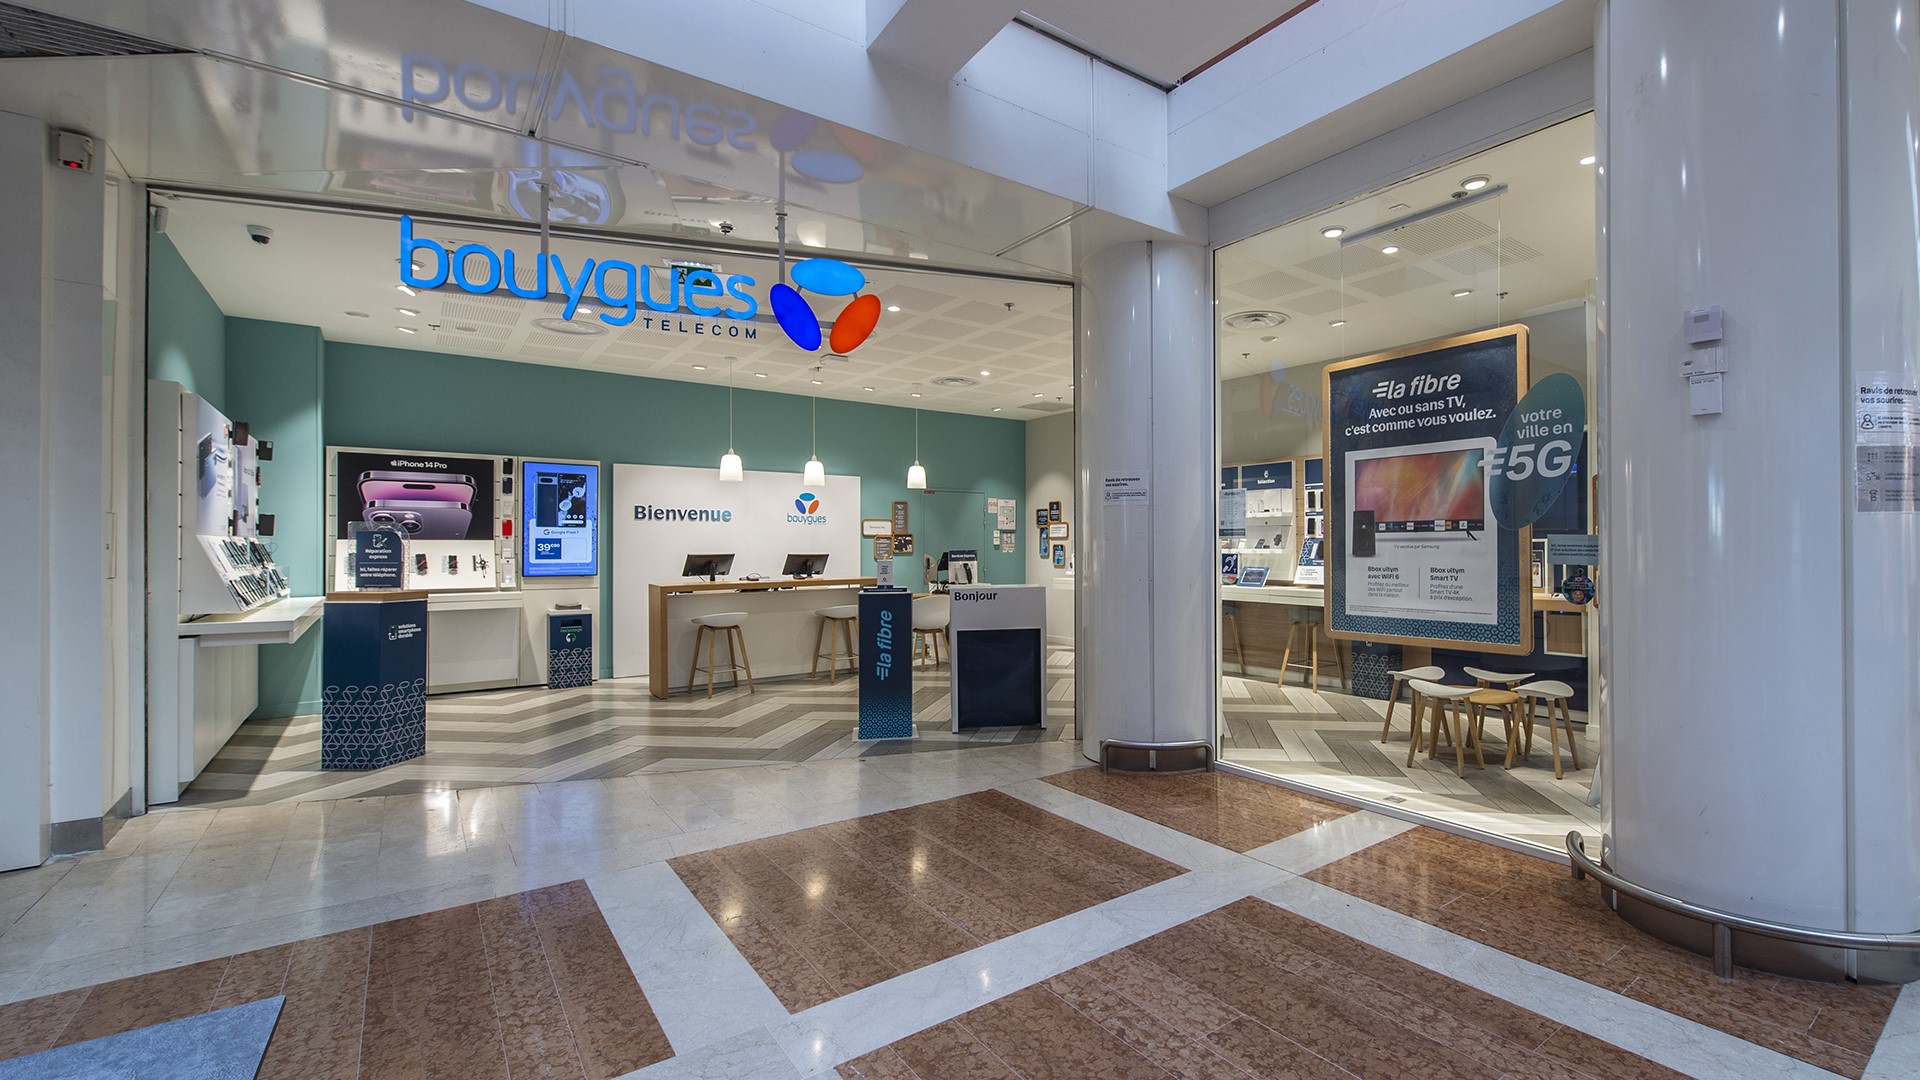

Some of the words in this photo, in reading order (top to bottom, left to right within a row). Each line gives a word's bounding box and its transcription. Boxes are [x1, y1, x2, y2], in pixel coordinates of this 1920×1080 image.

[400, 214, 758, 326] bouygues
[643, 317, 757, 339] TELECOM
[1387, 380, 1406, 399] la
[1409, 373, 1461, 396] fibre
[1860, 386, 1883, 394] Ravis
[1884, 387, 1893, 395] de
[1368, 407, 1396, 419] Avec
[1398, 404, 1413, 415] ou
[1415, 400, 1444, 413] sans
[1446, 395, 1466, 408] TV,
[1345, 424, 1371, 436] c'est
[1372, 418, 1415, 433] comme
[1416, 414, 1447, 427] vous
[1448, 408, 1497, 423] voulez.
[1520, 408, 1562, 424] votre
[1516, 424, 1549, 439] ville
[1552, 422, 1573, 434] en
[397, 460, 424, 468] iPhone
[1506, 439, 1572, 481] 5G
[634, 504, 732, 522] Bienvenue
[787, 512, 827, 525] bouygues
[1446, 567, 1465, 575] ultym
[954, 591, 998, 603] Bonjour
[876, 610, 893, 650] fibre
[876, 652, 892, 668] la
